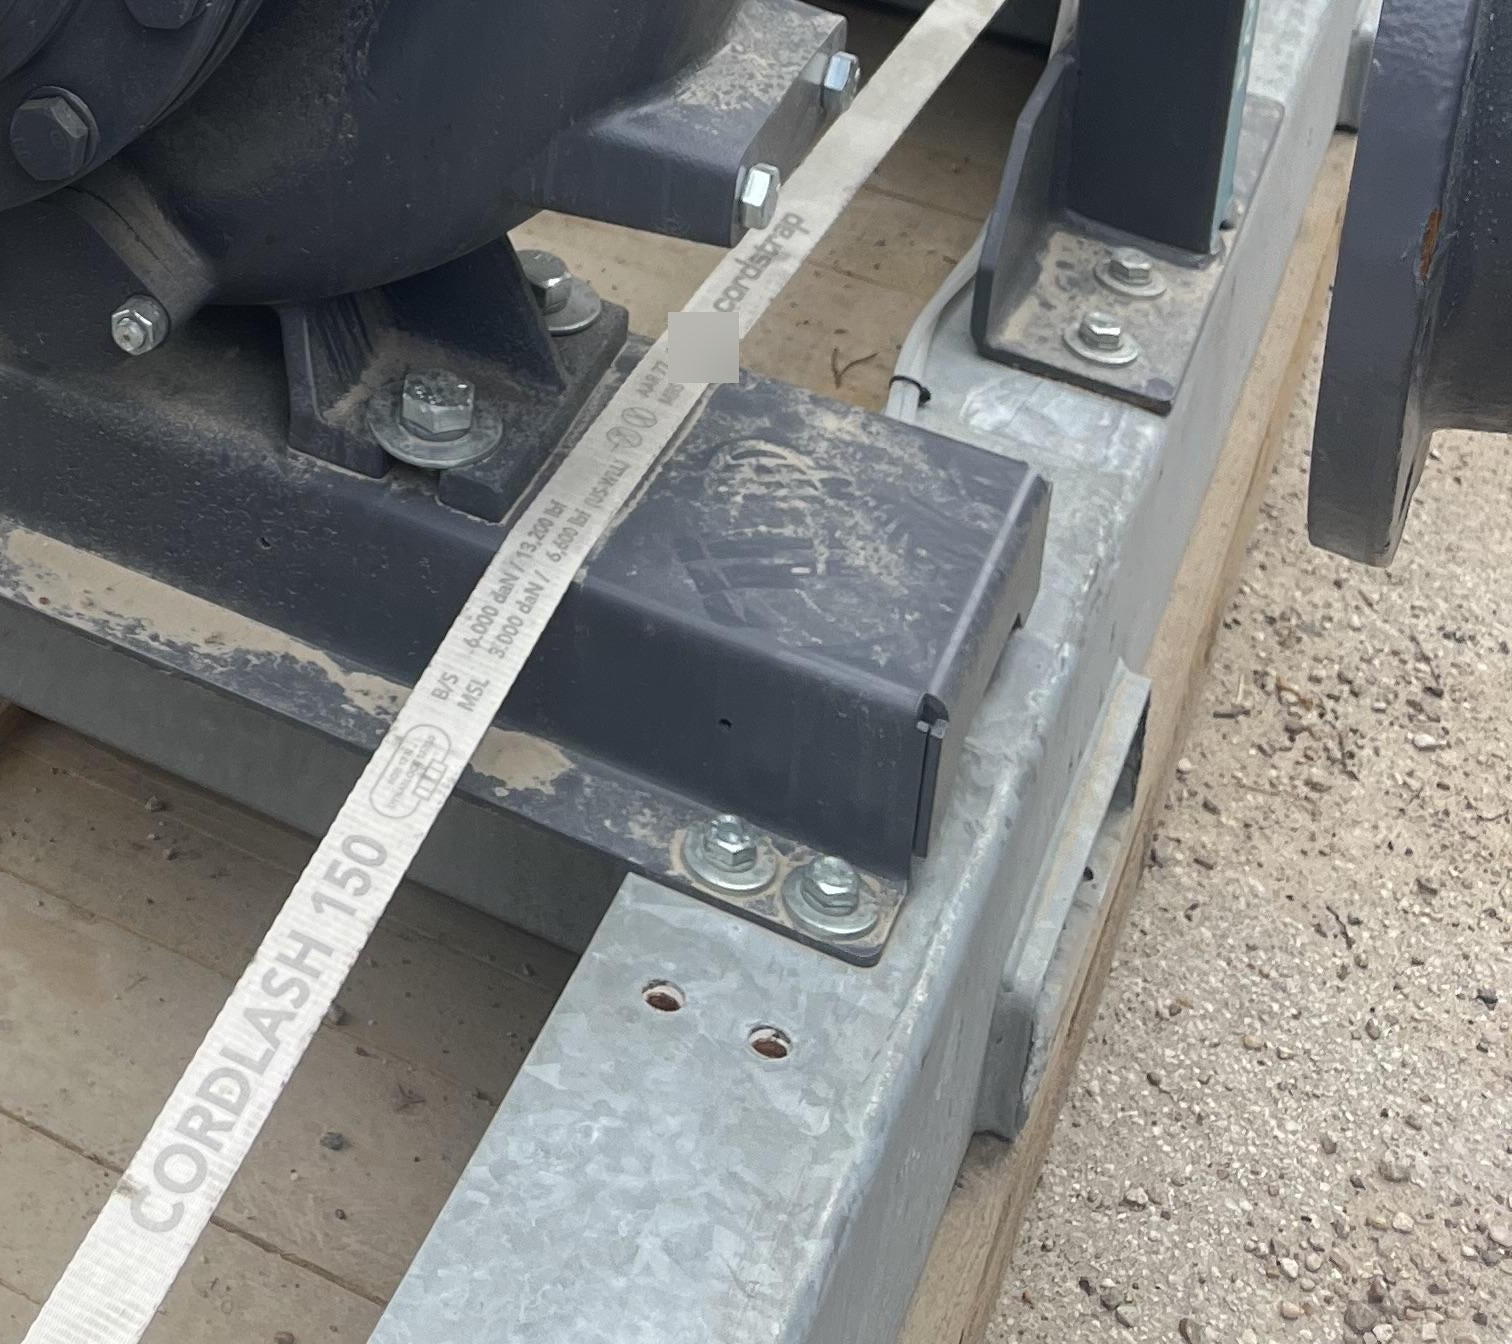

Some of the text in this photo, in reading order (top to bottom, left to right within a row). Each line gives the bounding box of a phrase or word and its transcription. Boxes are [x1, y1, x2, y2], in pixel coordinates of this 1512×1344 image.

[713, 212, 810, 313] cordstrap
[431, 672, 459, 701] B/S
[490, 572, 520, 604] daN
[457, 679, 490, 712] MSL
[515, 581, 544, 615] daN
[129, 833, 388, 1234] CORDLASH 150
